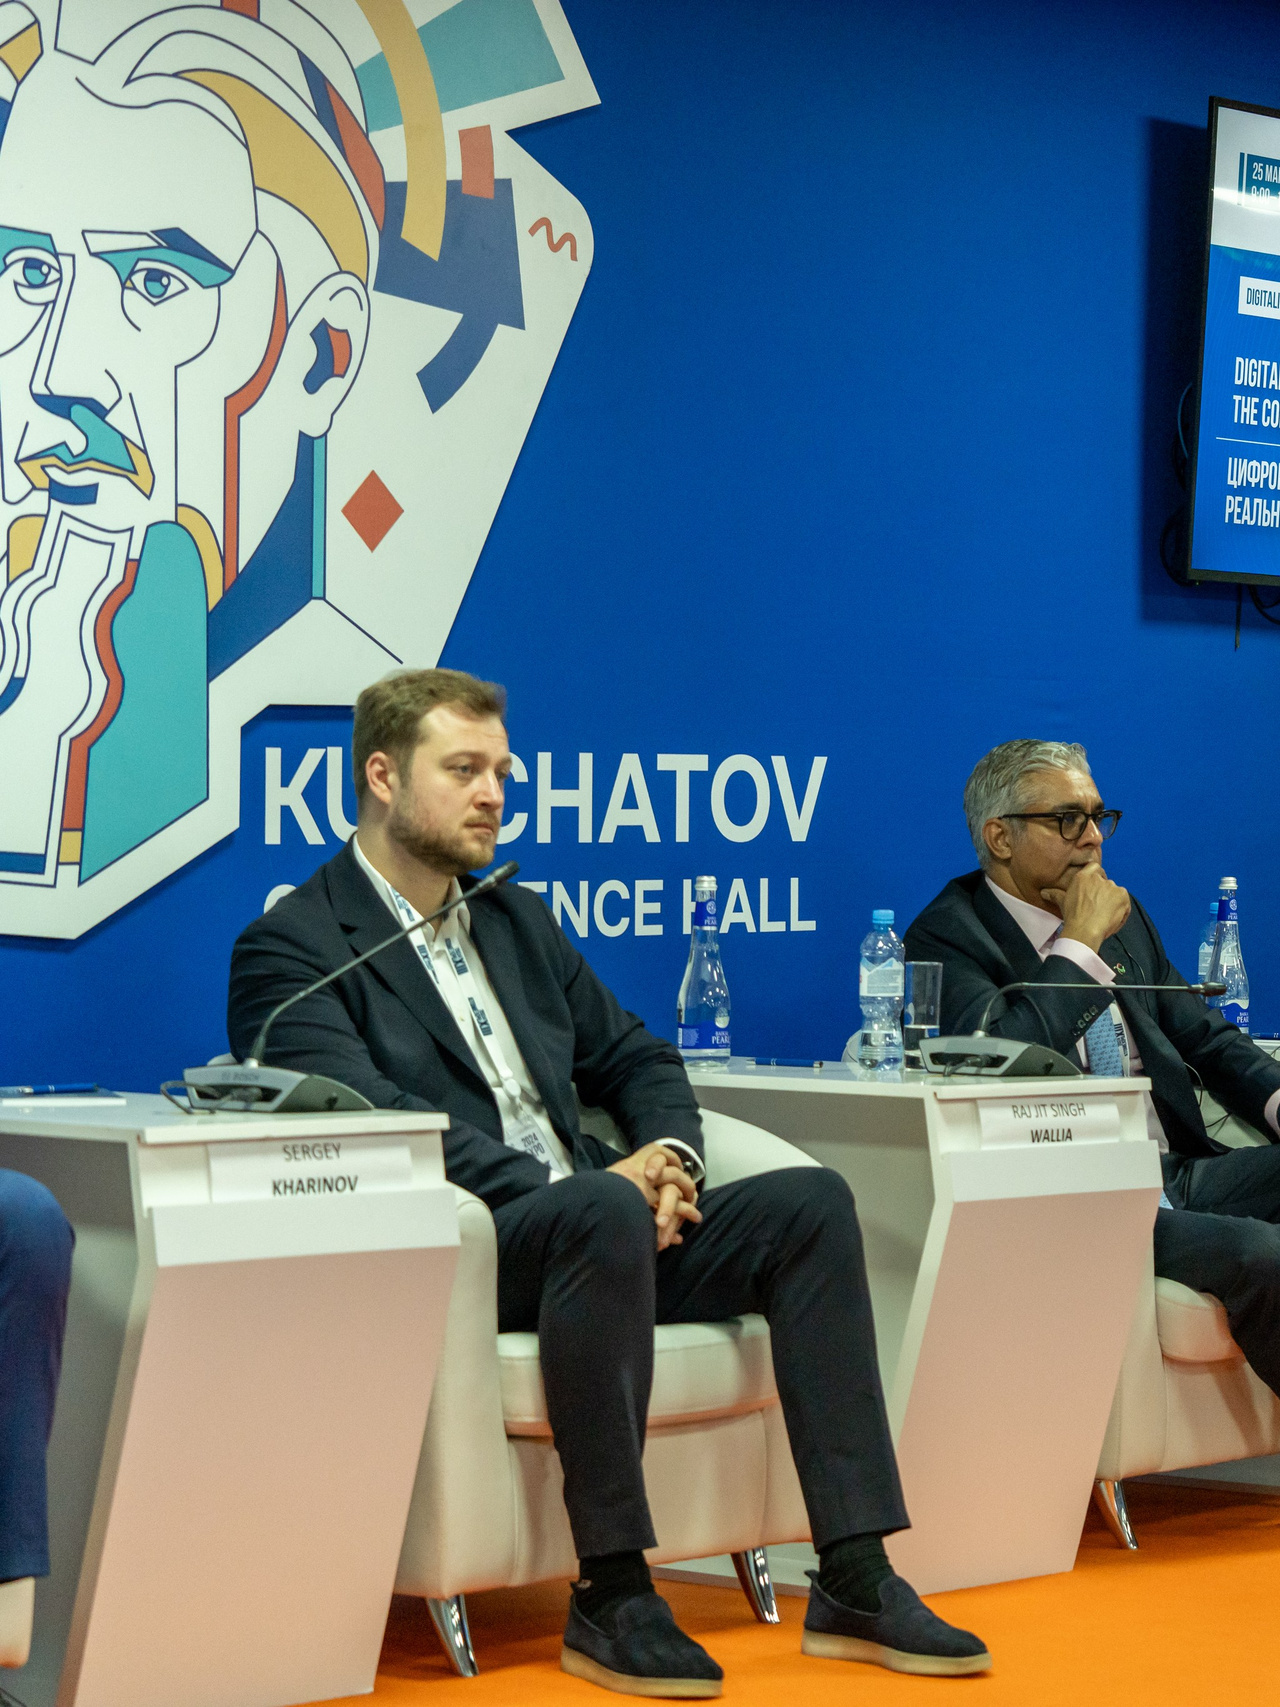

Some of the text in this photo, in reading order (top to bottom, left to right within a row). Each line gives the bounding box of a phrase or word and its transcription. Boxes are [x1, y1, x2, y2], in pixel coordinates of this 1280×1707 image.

[1252, 162, 1263, 181] 25
[1233, 395, 1258, 425] THE
[264, 746, 828, 845] KUCHATOV
[1012, 1102, 1087, 1119] RAJ JIT SINGH
[1030, 1128, 1073, 1143] WALLIA
[282, 1142, 342, 1162] SERGEY
[271, 1175, 358, 1197] KHARINOV
